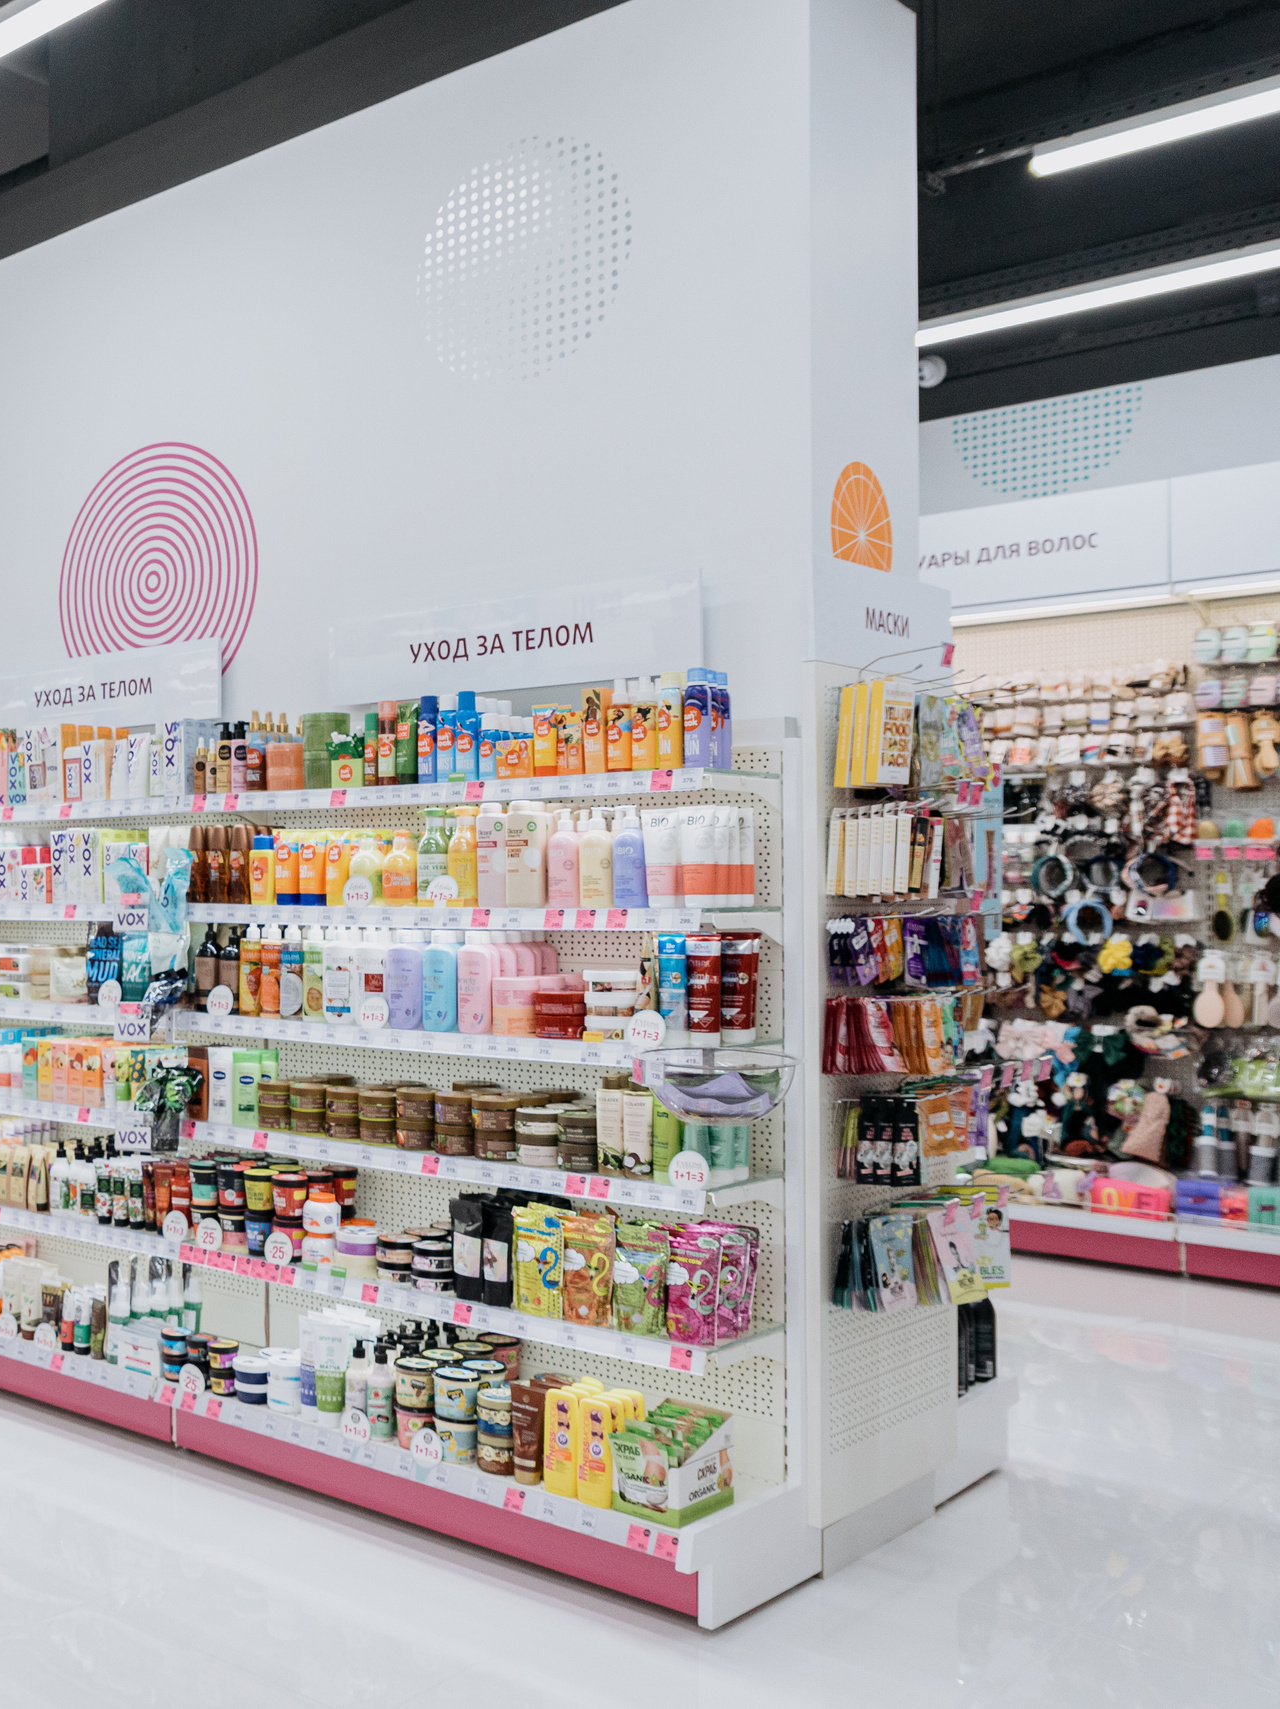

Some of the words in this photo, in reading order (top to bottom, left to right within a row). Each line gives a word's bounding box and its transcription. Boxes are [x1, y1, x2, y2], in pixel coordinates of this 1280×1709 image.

[976, 542, 1020, 564] ДЛЯ
[1028, 531, 1100, 557] ВОЛОС
[864, 605, 910, 639] МАСКИ
[409, 638, 469, 664] УХОД
[476, 633, 505, 656] ЗА
[512, 621, 595, 652] ТЕЛОМ
[33, 687, 74, 709] УХОД
[78, 683, 97, 702] ЗА
[100, 676, 153, 700] ТЕЛОМ
[25, 729, 33, 763] VOX
[165, 722, 175, 768] VOX
[9, 753, 18, 790] VOX
[83, 744, 92, 784] VOX
[8, 793, 27, 804] VOX
[650, 817, 669, 828] BIO
[687, 816, 706, 827] BIO
[52, 834, 62, 876] VOX
[68, 833, 76, 864] VOX
[82, 833, 92, 876] VOX
[346, 892, 369, 901] 1+1=3
[117, 912, 145, 926] VOX
[86, 961, 119, 982] MUD
[362, 1013, 385, 1022] 1+1=3
[118, 1022, 147, 1037] VOX
[630, 1027, 660, 1042] 1+1=3
[118, 1130, 148, 1145] VOX
[673, 1169, 705, 1184] 1+1=3
[344, 1424, 367, 1439] 1+1=3
[414, 1444, 440, 1460] 1+1=3
